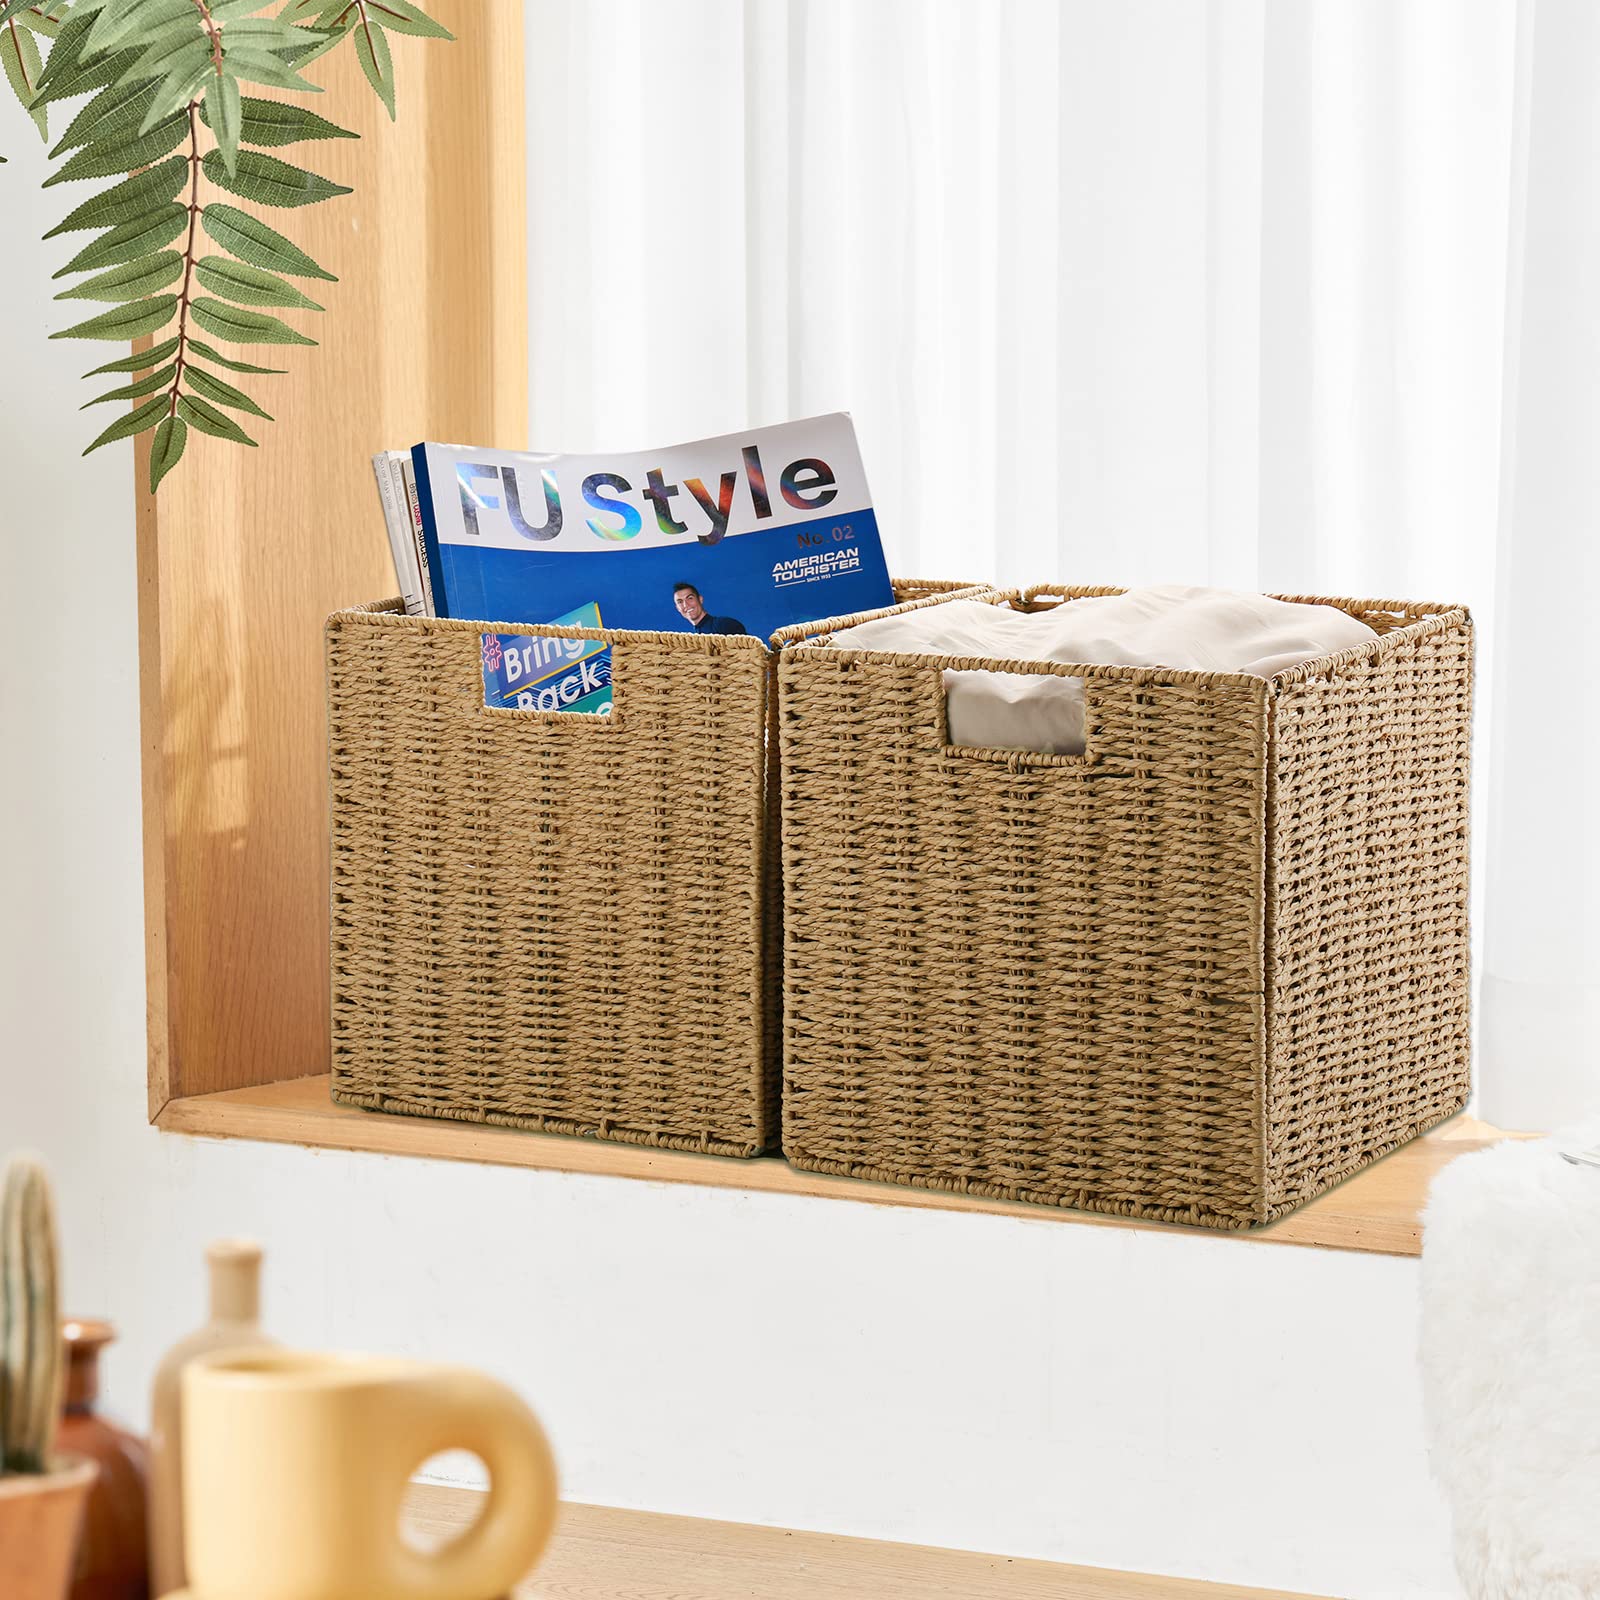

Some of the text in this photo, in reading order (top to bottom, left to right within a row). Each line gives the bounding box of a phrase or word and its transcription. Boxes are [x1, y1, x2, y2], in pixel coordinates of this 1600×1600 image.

[455, 462, 563, 541] FU
[581, 445, 838, 546] Style
[418, 529, 428, 568] SUCCESS
[772, 547, 859, 572] AMERICAN
[772, 558, 860, 582] TOURISTER
[517, 660, 603, 710] Back
